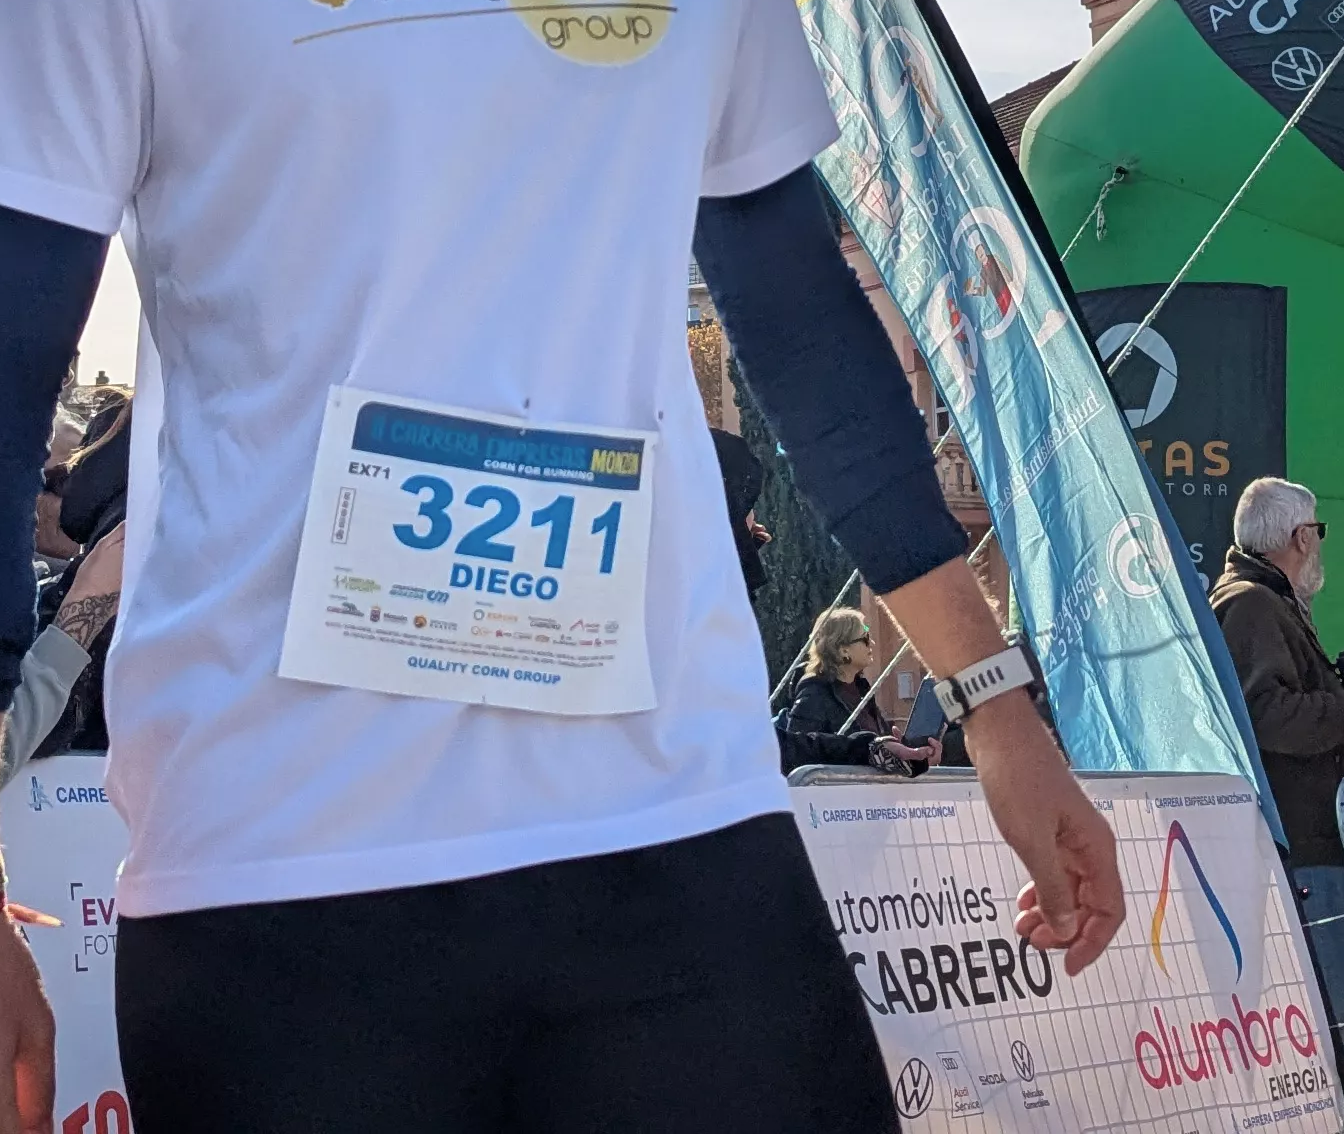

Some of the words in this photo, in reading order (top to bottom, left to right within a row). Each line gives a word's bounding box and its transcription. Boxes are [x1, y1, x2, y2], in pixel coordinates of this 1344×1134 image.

[542, 12, 652, 49] group
[349, 461, 391, 481] EX71
[484, 459, 515, 473] CORN
[517, 464, 542, 476] FOR
[543, 468, 594, 482] RUNNING
[392, 474, 623, 575] 3211
[449, 563, 559, 601] DIEGO
[407, 656, 468, 674] QUALITY
[471, 663, 511, 679] CORN
[513, 668, 562, 685] GROUP
[823, 809, 863, 823] CARRERA
[866, 807, 907, 821] EMPRESAS
[82, 898, 119, 927] EV
[826, 875, 997, 936] utomóviles
[1135, 993, 1317, 1089] alumbra
[1268, 1061, 1329, 1101] ENERGÍA
[954, 1101, 981, 1113] Service
[1243, 1116, 1273, 1130] CARRERA
